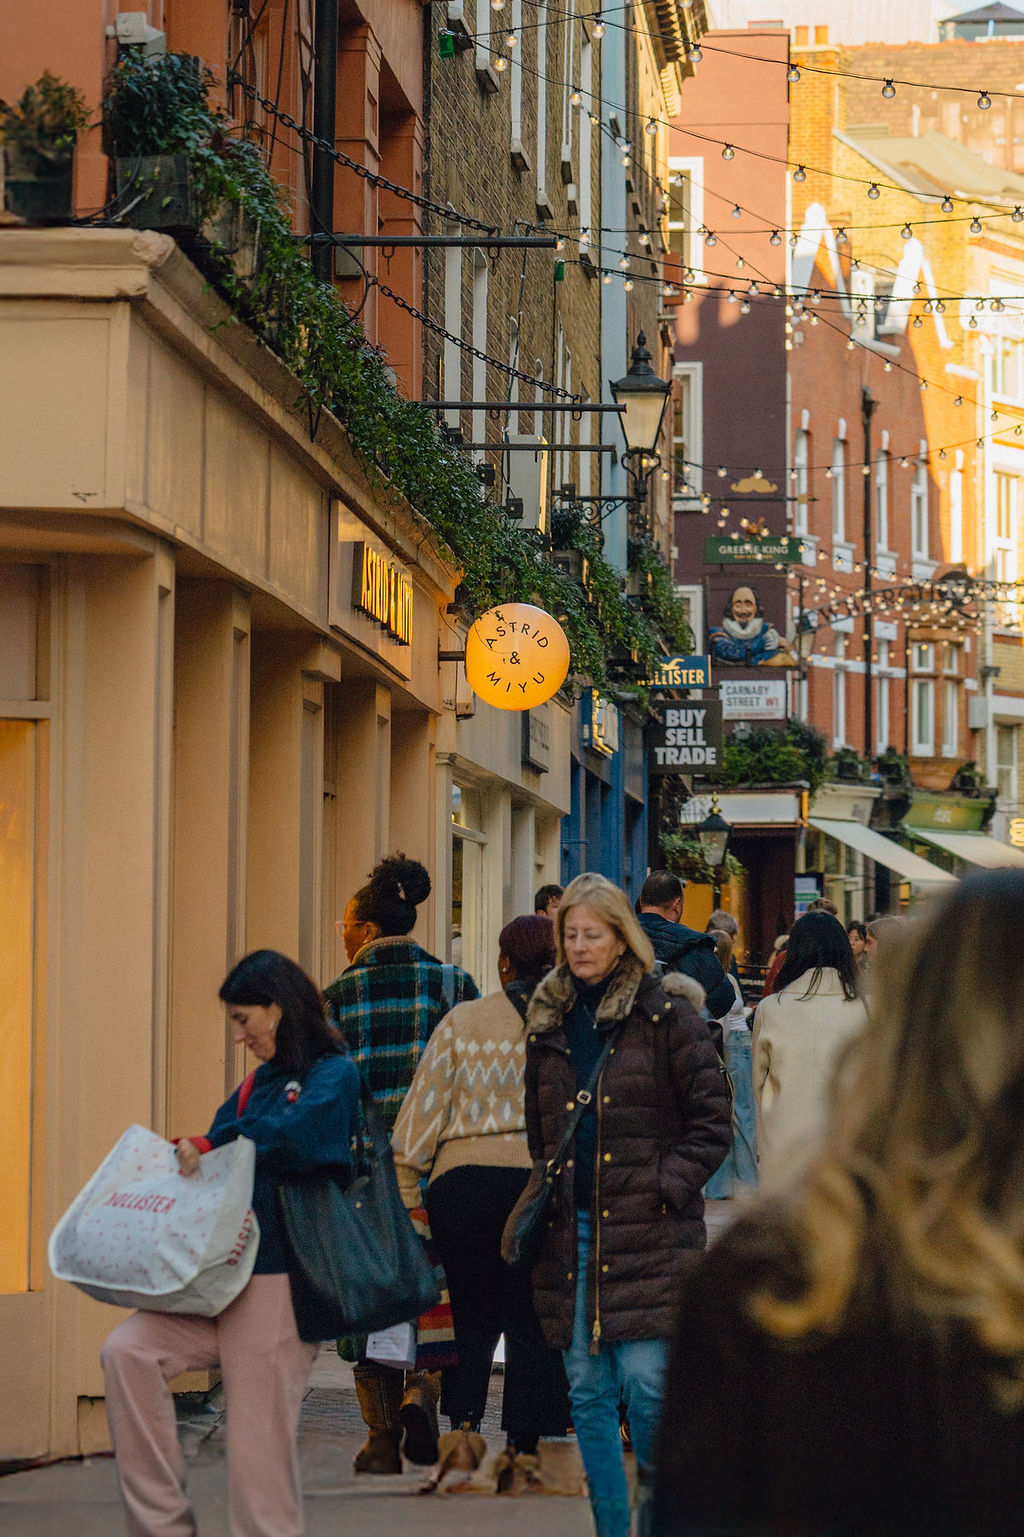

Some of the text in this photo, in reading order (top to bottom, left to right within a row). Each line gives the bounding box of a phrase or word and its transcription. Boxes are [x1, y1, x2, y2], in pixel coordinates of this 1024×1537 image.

[762, 544, 789, 554] KING
[486, 622, 548, 648] ASTRID
[509, 651, 520, 665] &
[486, 671, 545, 693] MIYU
[726, 685, 769, 695] CARNABY
[726, 696, 760, 706] STREET
[666, 709, 706, 727] BUY
[665, 728, 706, 746] SELL
[654, 747, 716, 765] TRADE
